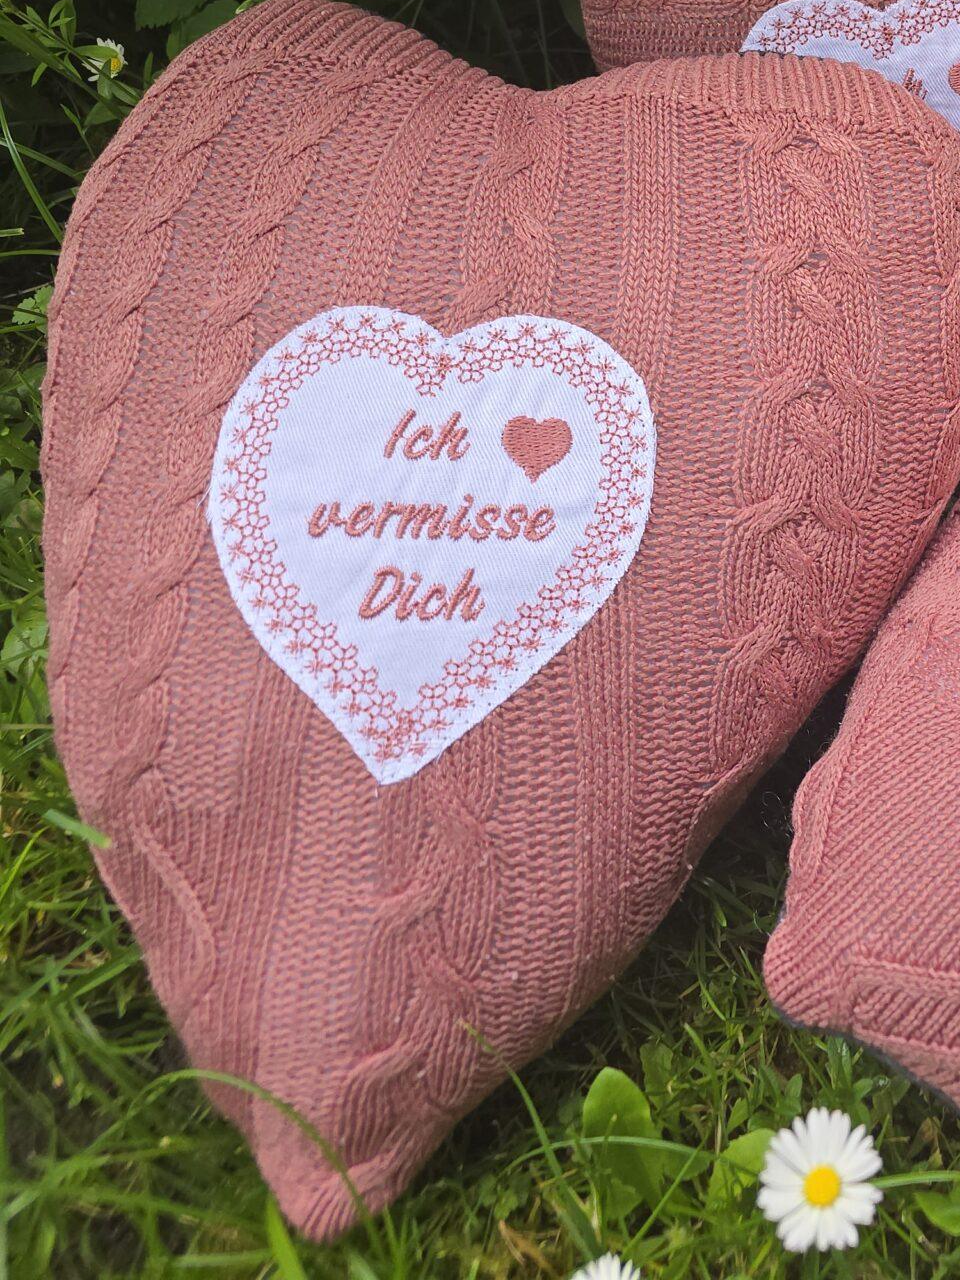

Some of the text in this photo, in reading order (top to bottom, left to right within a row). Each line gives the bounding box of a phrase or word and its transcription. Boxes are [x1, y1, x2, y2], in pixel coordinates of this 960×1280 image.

[382, 408, 471, 461] Ich
[307, 494, 556, 542] vermisse
[357, 565, 486, 621] Dich
